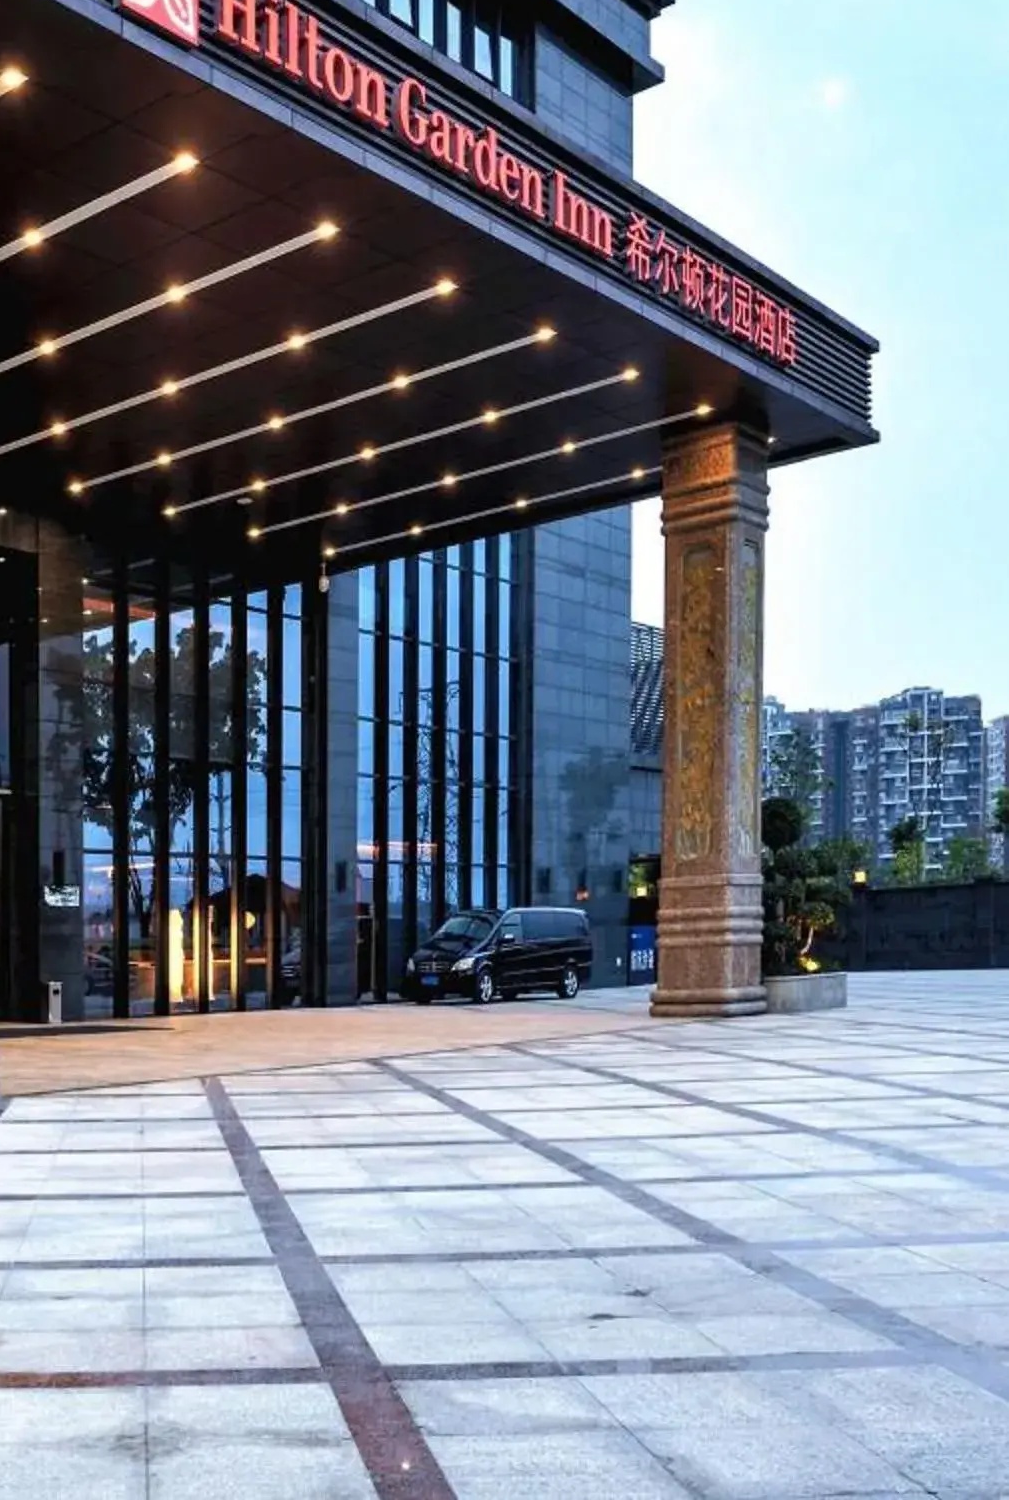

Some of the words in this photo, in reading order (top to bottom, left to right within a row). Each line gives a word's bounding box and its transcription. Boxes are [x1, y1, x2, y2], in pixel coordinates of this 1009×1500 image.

[399, 77, 545, 219] Garden
[553, 169, 613, 257] Inn
[626, 211, 797, 366] 希尔顿花园酒店
